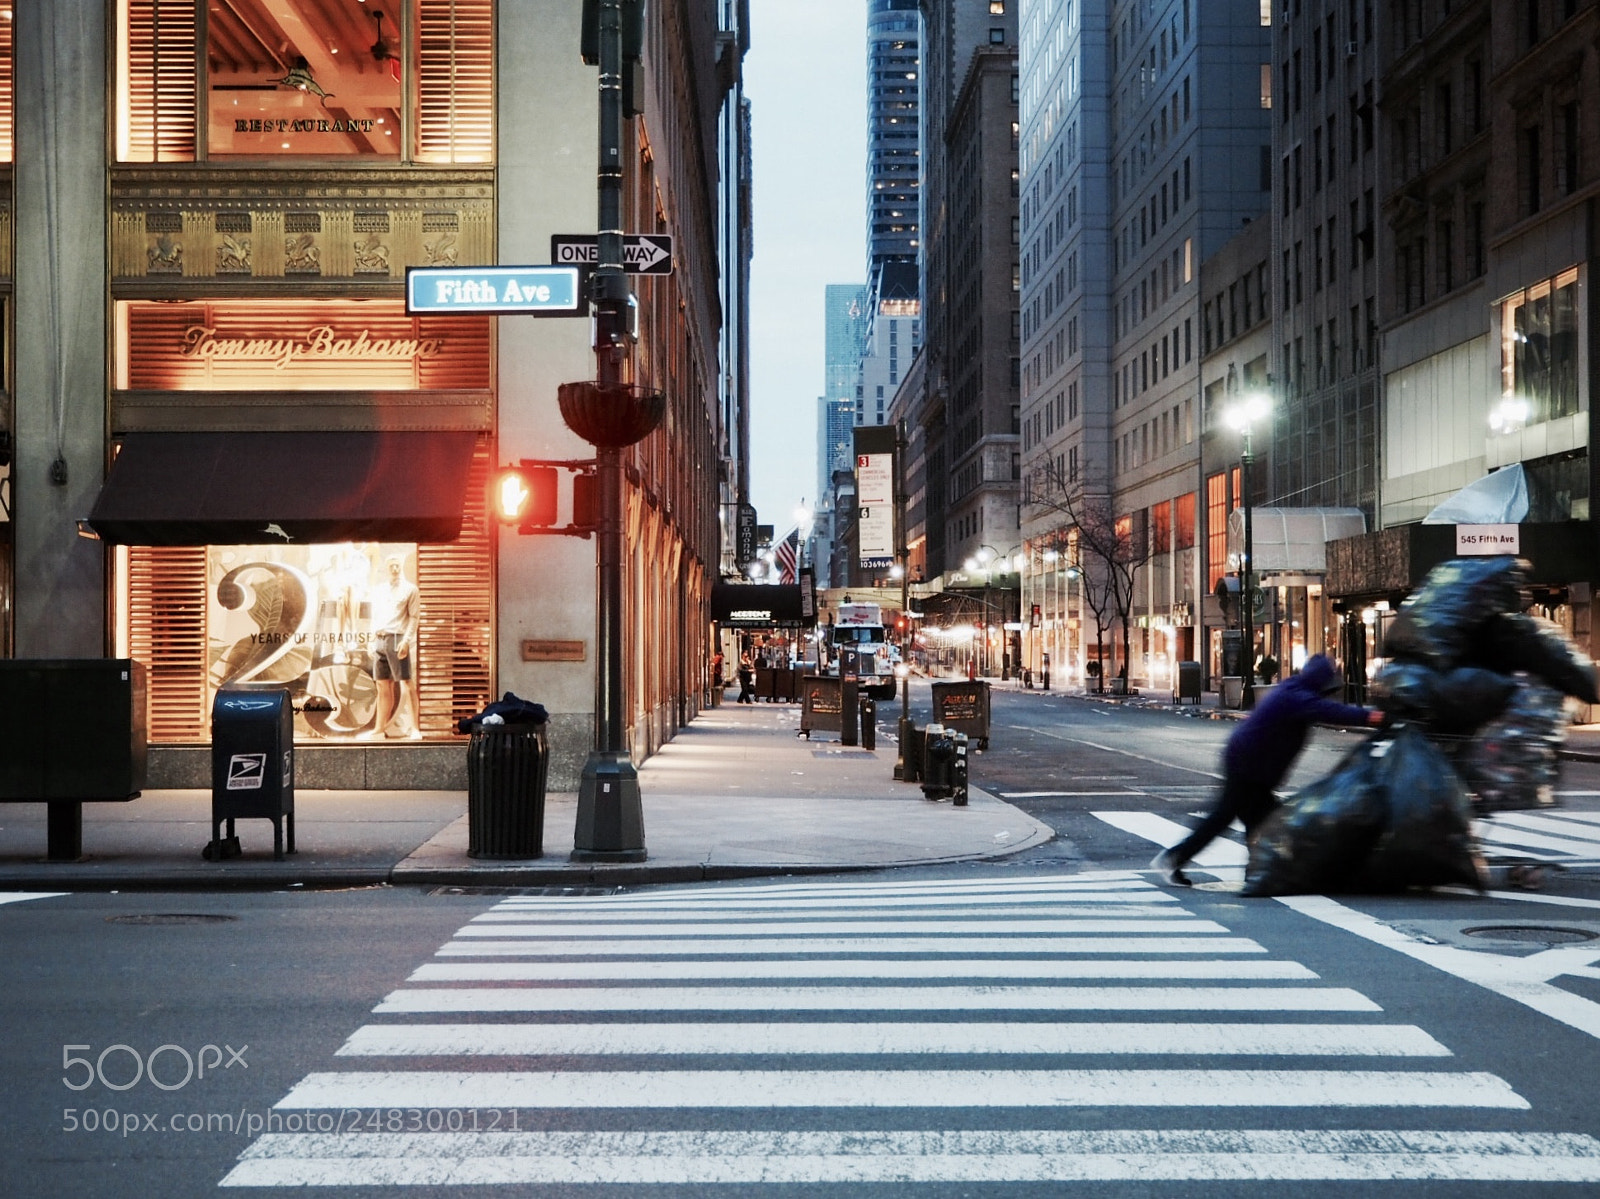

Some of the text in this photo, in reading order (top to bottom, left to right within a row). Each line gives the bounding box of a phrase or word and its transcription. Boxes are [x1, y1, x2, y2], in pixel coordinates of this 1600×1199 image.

[234, 118, 374, 132] RESTAURANT
[561, 245, 658, 262] ONE WAY
[436, 279, 551, 304] Fifth Ave
[181, 325, 441, 370] Tommy Bahama
[861, 457, 867, 467] 3
[861, 508, 868, 518] 6
[1461, 535, 1515, 544] 545 Fifth Ave
[250, 631, 373, 645] YEARS OF PARADISE
[848, 653, 856, 663] P
